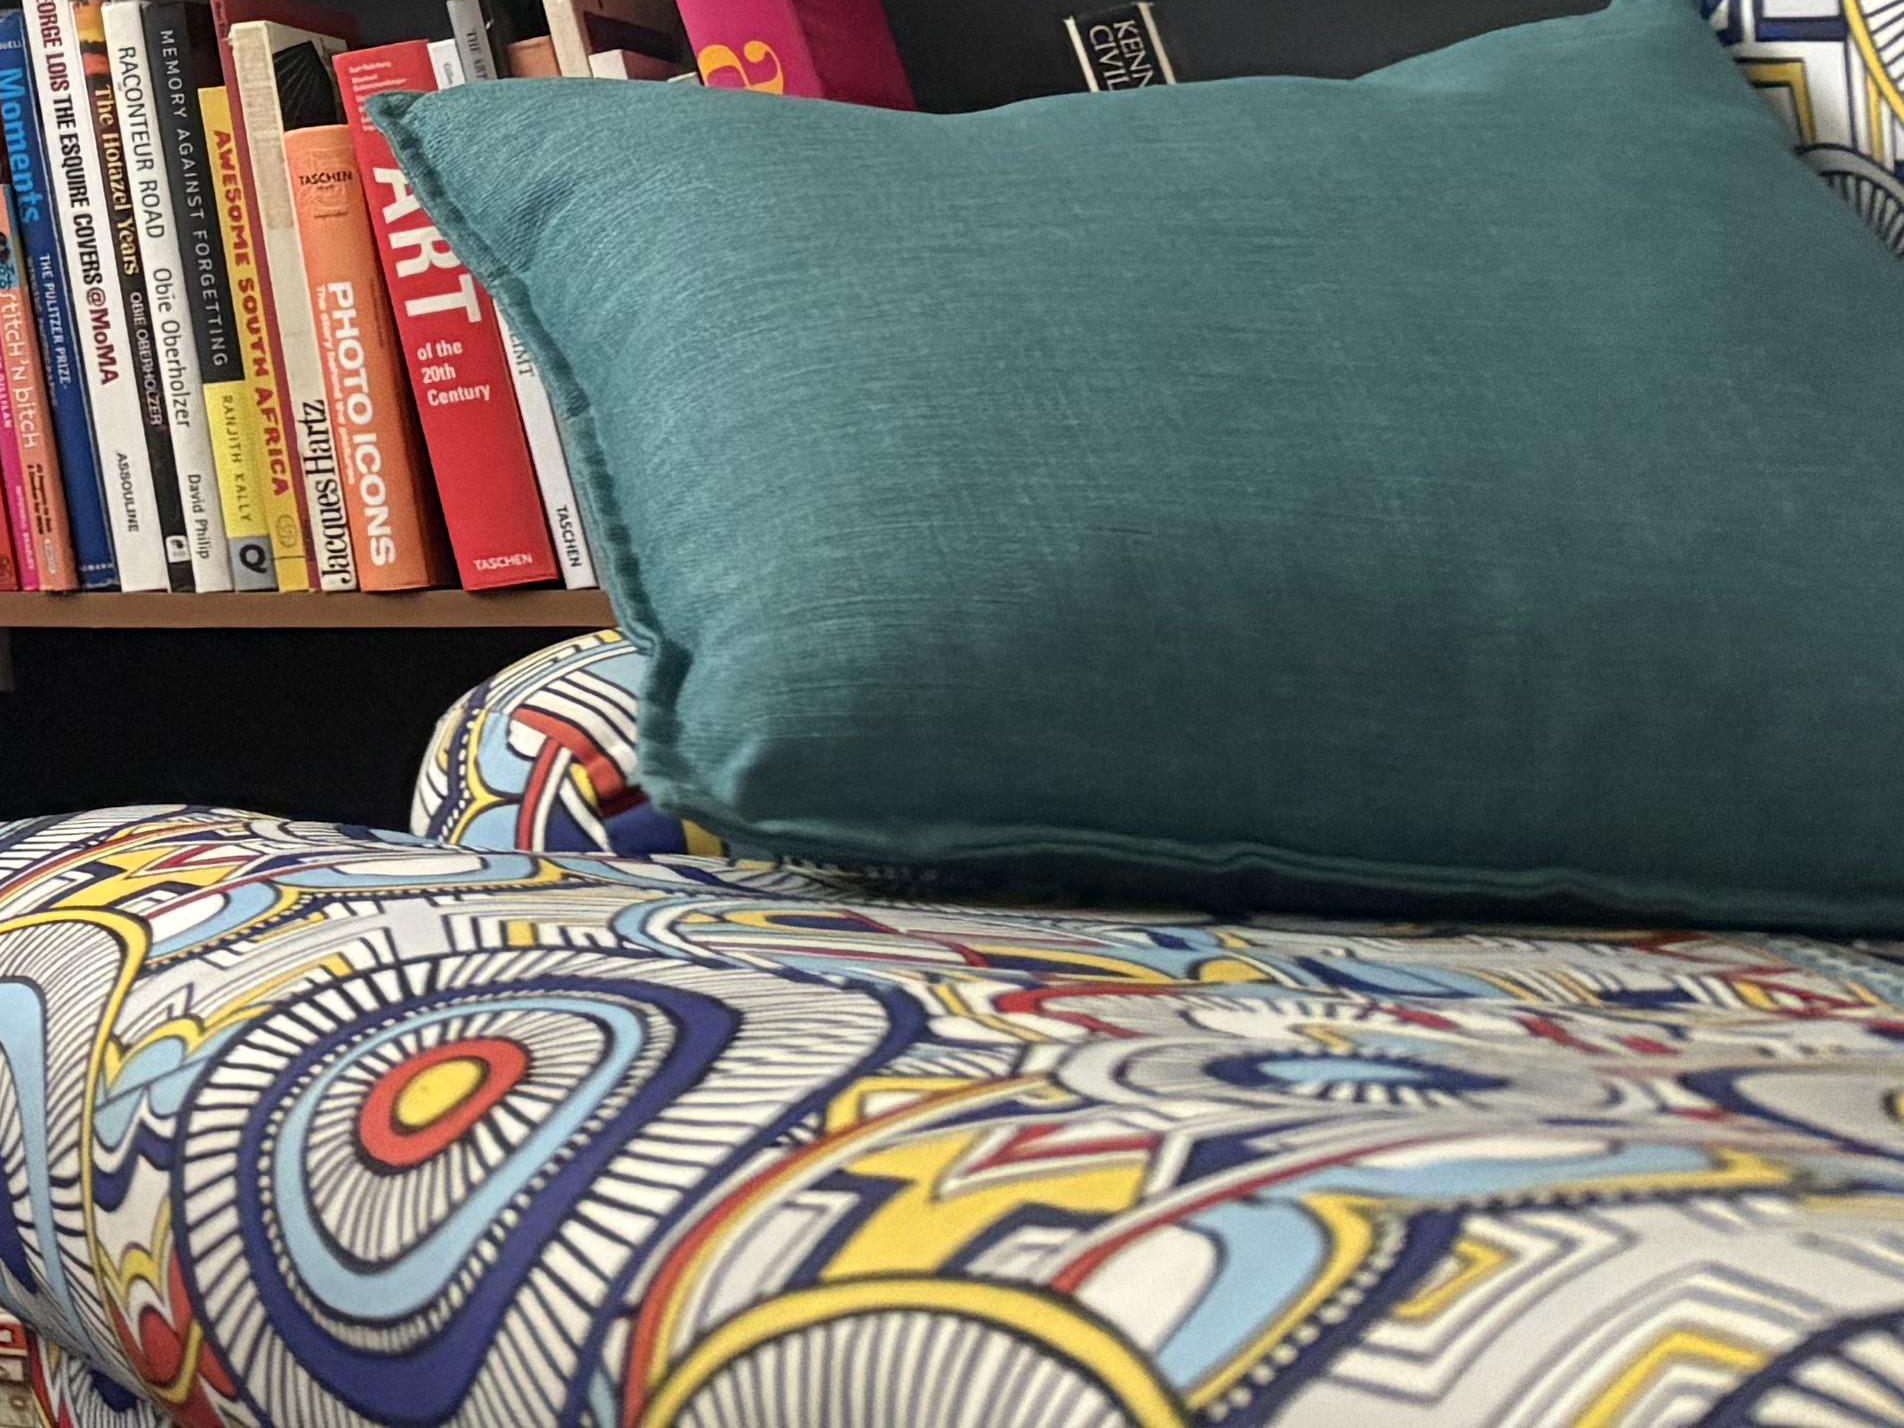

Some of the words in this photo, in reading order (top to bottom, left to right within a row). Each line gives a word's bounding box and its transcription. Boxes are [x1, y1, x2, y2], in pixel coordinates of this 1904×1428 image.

[159, 29, 187, 118] MEMORY
[177, 127, 203, 221] AGAINST
[192, 228, 229, 368] FORGETTING
[299, 169, 353, 186] TASCHEN
[213, 130, 251, 267] AWESOME
[236, 279, 269, 377] SOUTH
[255, 389, 289, 498] AFRICA
[417, 343, 431, 361] of
[435, 340, 464, 358] the
[421, 363, 457, 383] 20th
[326, 281, 374, 426] PHOTO
[353, 432, 396, 567] ICONS
[427, 382, 492, 406] Century
[303, 398, 338, 477] Hartz
[320, 478, 357, 585] Jacques
[474, 551, 534, 571] TASCHEN
[555, 505, 582, 569] TASCHEN
